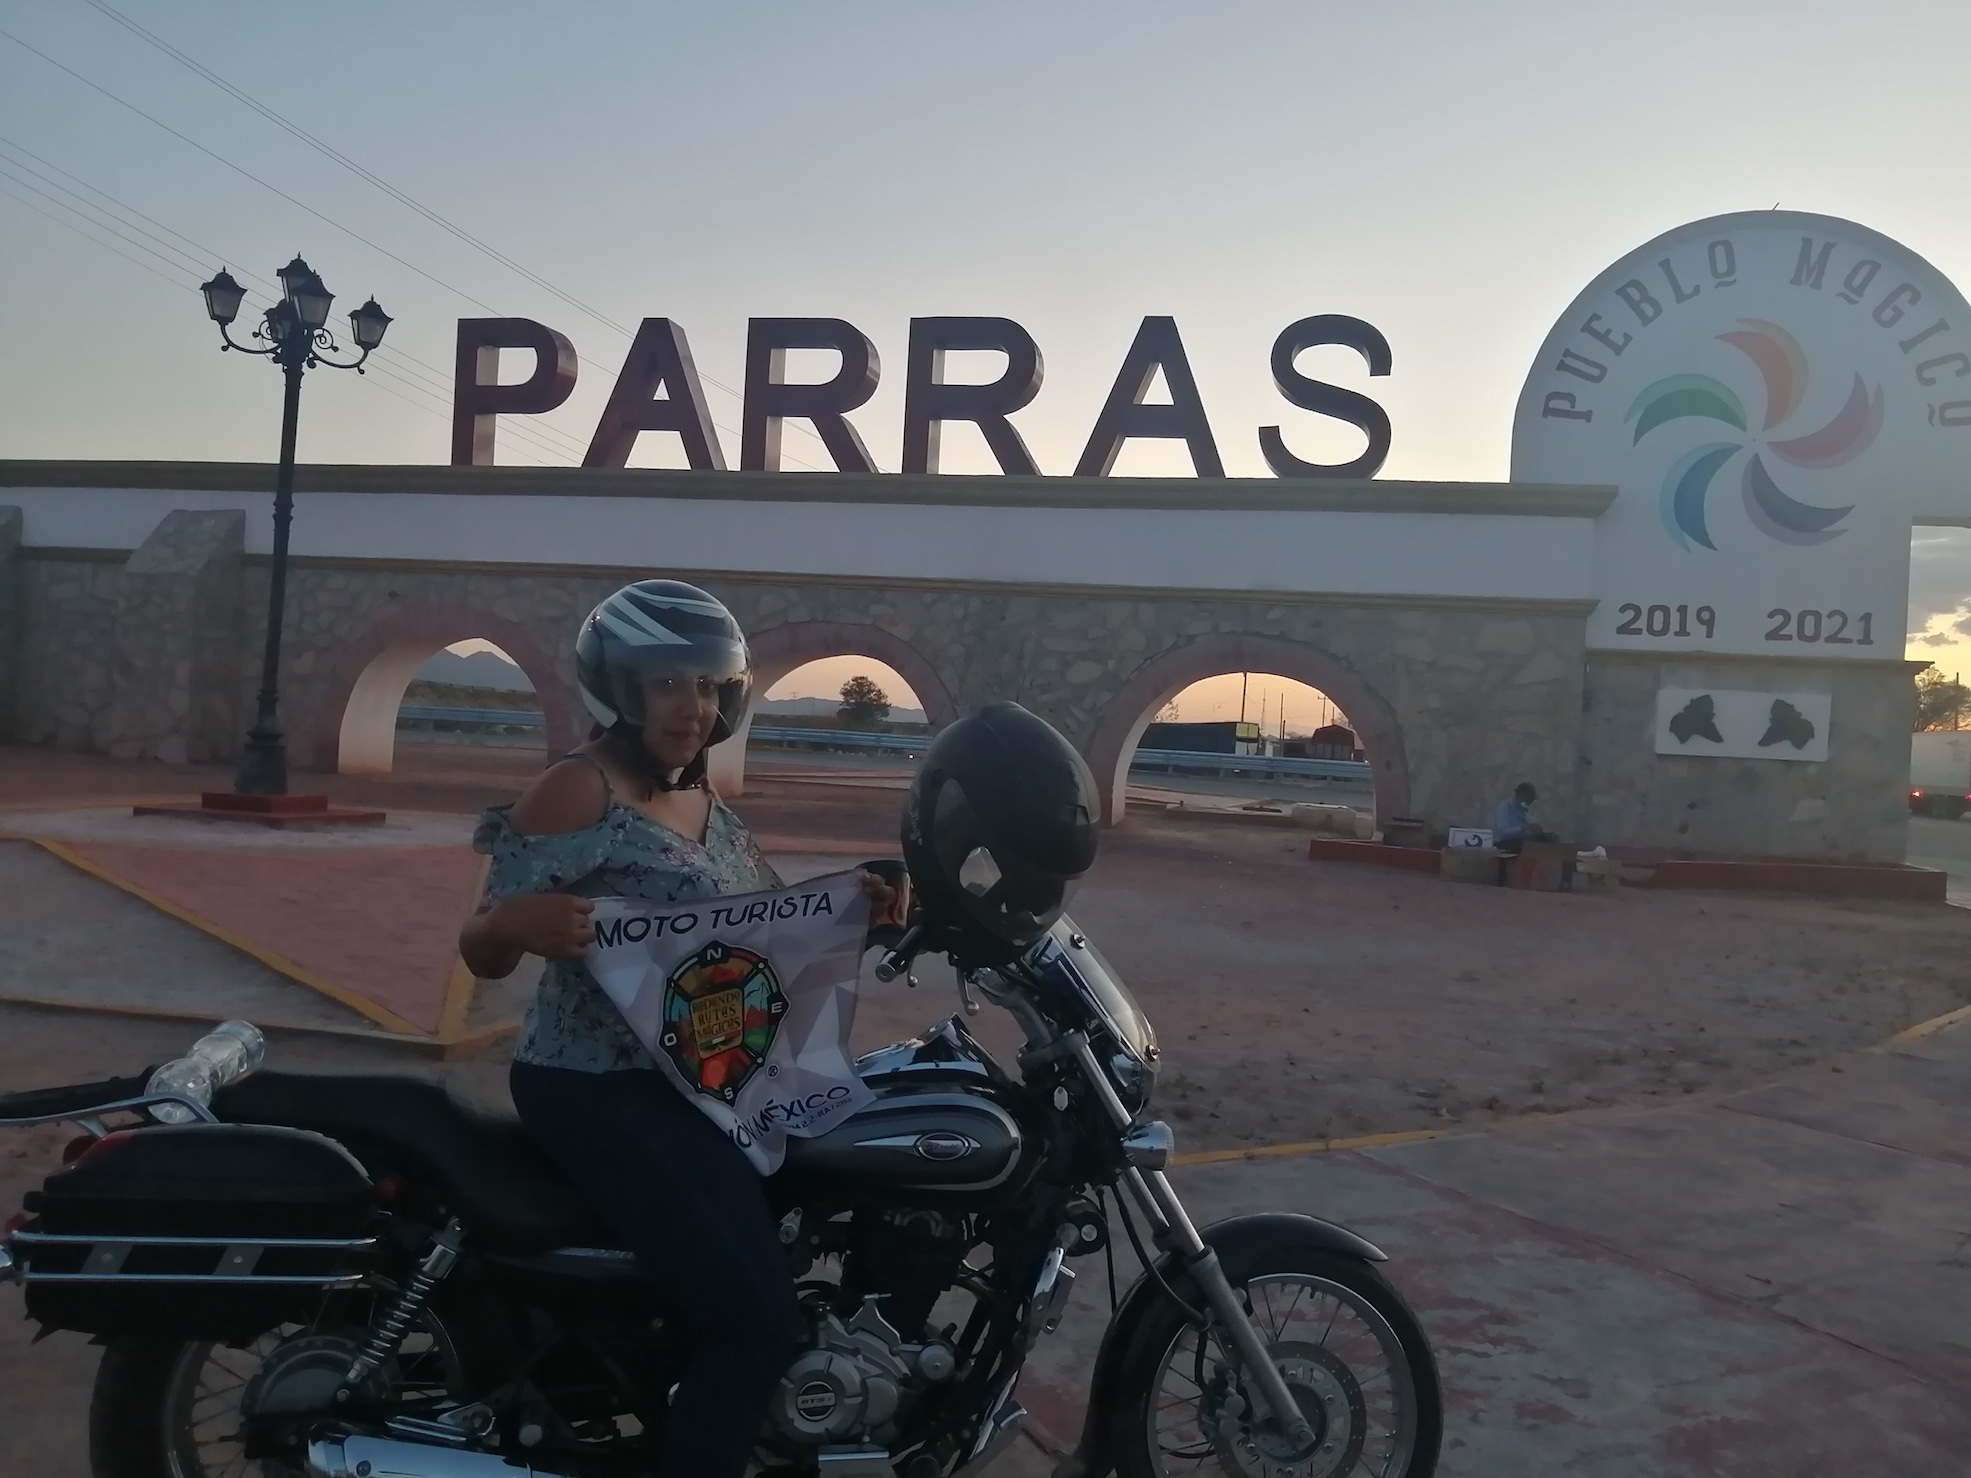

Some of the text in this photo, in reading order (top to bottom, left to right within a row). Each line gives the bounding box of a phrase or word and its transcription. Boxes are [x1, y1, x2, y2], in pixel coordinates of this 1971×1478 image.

[1541, 238, 1738, 423] PUEBLO
[451, 313, 1393, 480] PARRAS
[1615, 602, 1874, 645] 2019 2021
[595, 892, 833, 949] MOTO TURISTA
[706, 947, 722, 959] N
[771, 1001, 783, 1014] E
[663, 1032, 676, 1046] O
[724, 1087, 733, 1099] S
[752, 1086, 851, 1137] MÉXICO
